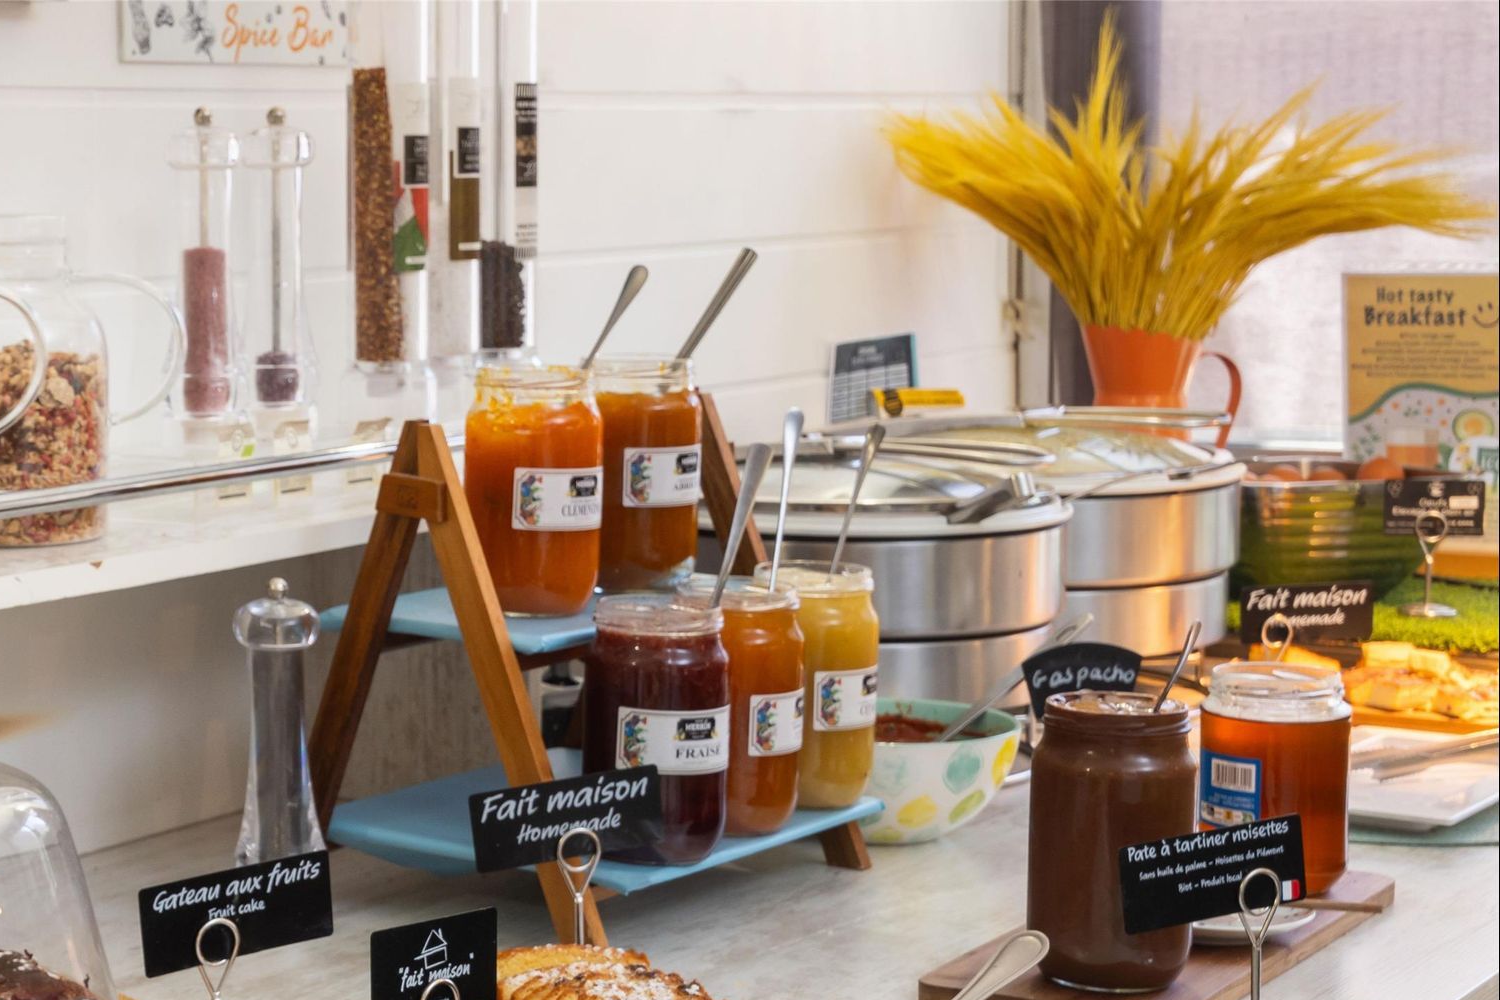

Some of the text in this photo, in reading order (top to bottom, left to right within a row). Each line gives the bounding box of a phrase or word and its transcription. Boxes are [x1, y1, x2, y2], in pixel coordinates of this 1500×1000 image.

[221, 3, 334, 64] Spice Bar
[1376, 286, 1454, 305] Hot tasty
[1364, 304, 1466, 327] Breakfast
[1246, 584, 1368, 612] Fait maison
[1031, 664, 1136, 690] Gaspacho
[675, 746, 721, 759] FRAISE
[480, 776, 649, 824] Fait maison
[516, 806, 622, 845] Homemade
[1127, 819, 1290, 864] Pate à tartiner noisettes
[1157, 866, 1174, 878] huile
[1175, 864, 1184, 874] de
[1185, 859, 1208, 876] palme
[1214, 853, 1245, 866] Noisettes
[152, 860, 322, 914] Gateau aux fruits
[1200, 876, 1225, 889] Produit
[1226, 871, 1243, 884] local
[207, 898, 267, 921] Fruit cake
